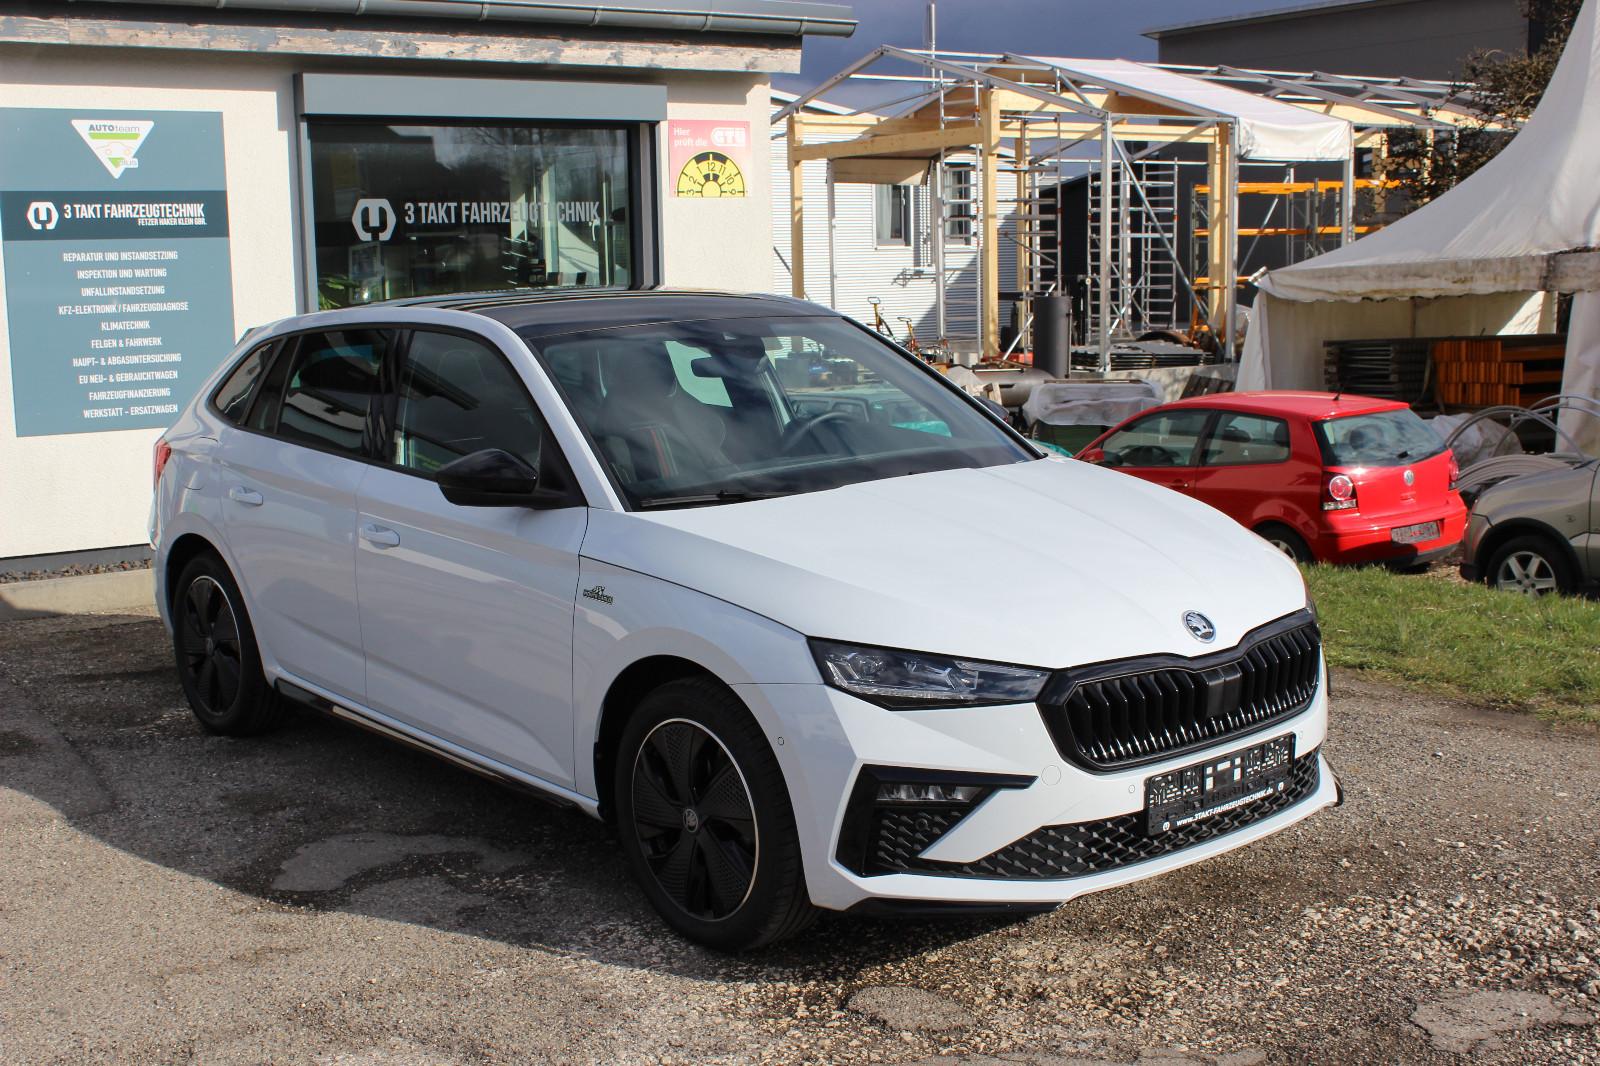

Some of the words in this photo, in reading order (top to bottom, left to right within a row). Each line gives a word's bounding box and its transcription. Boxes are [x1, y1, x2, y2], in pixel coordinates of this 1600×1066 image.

[707, 162, 716, 171] 12
[64, 204, 72, 218] 3
[73, 204, 102, 218] TAKT
[104, 203, 205, 218] FAHRZEUGTECHNIK
[404, 202, 414, 223] 3
[418, 202, 458, 223] TAKT
[63, 252, 103, 262] REPARATUR
[105, 252, 118, 261] UND
[120, 251, 178, 261] INSTANDSETZUNG
[77, 269, 118, 279] INSPEKTION
[119, 269, 133, 278] UND
[135, 268, 167, 278] WARTUNG
[81, 286, 165, 296] UNFALLINSTANDSETZUNG
[59, 304, 117, 315] KFZ-ELEKTRONIK
[122, 302, 189, 312] FAHRZEUGDIAGNOSE
[101, 321, 150, 331] KLIMATECHNIK
[91, 340, 117, 348] FELGEN
[119, 339, 124, 348] &
[125, 337, 162, 347] FAHRWERK
[73, 357, 98, 367] HAUPT-
[108, 353, 181, 365] ABGASUNTERSUCHUNG
[79, 375, 89, 384] EU
[90, 374, 107, 384] NEU-
[116, 371, 178, 382] GEBRAUCHTWAGEN
[89, 388, 171, 400] FAHRZEUGFINANZIERUNG
[83, 408, 123, 418] WERKSTATT
[130, 404, 178, 416] ERSATZWAGEN
